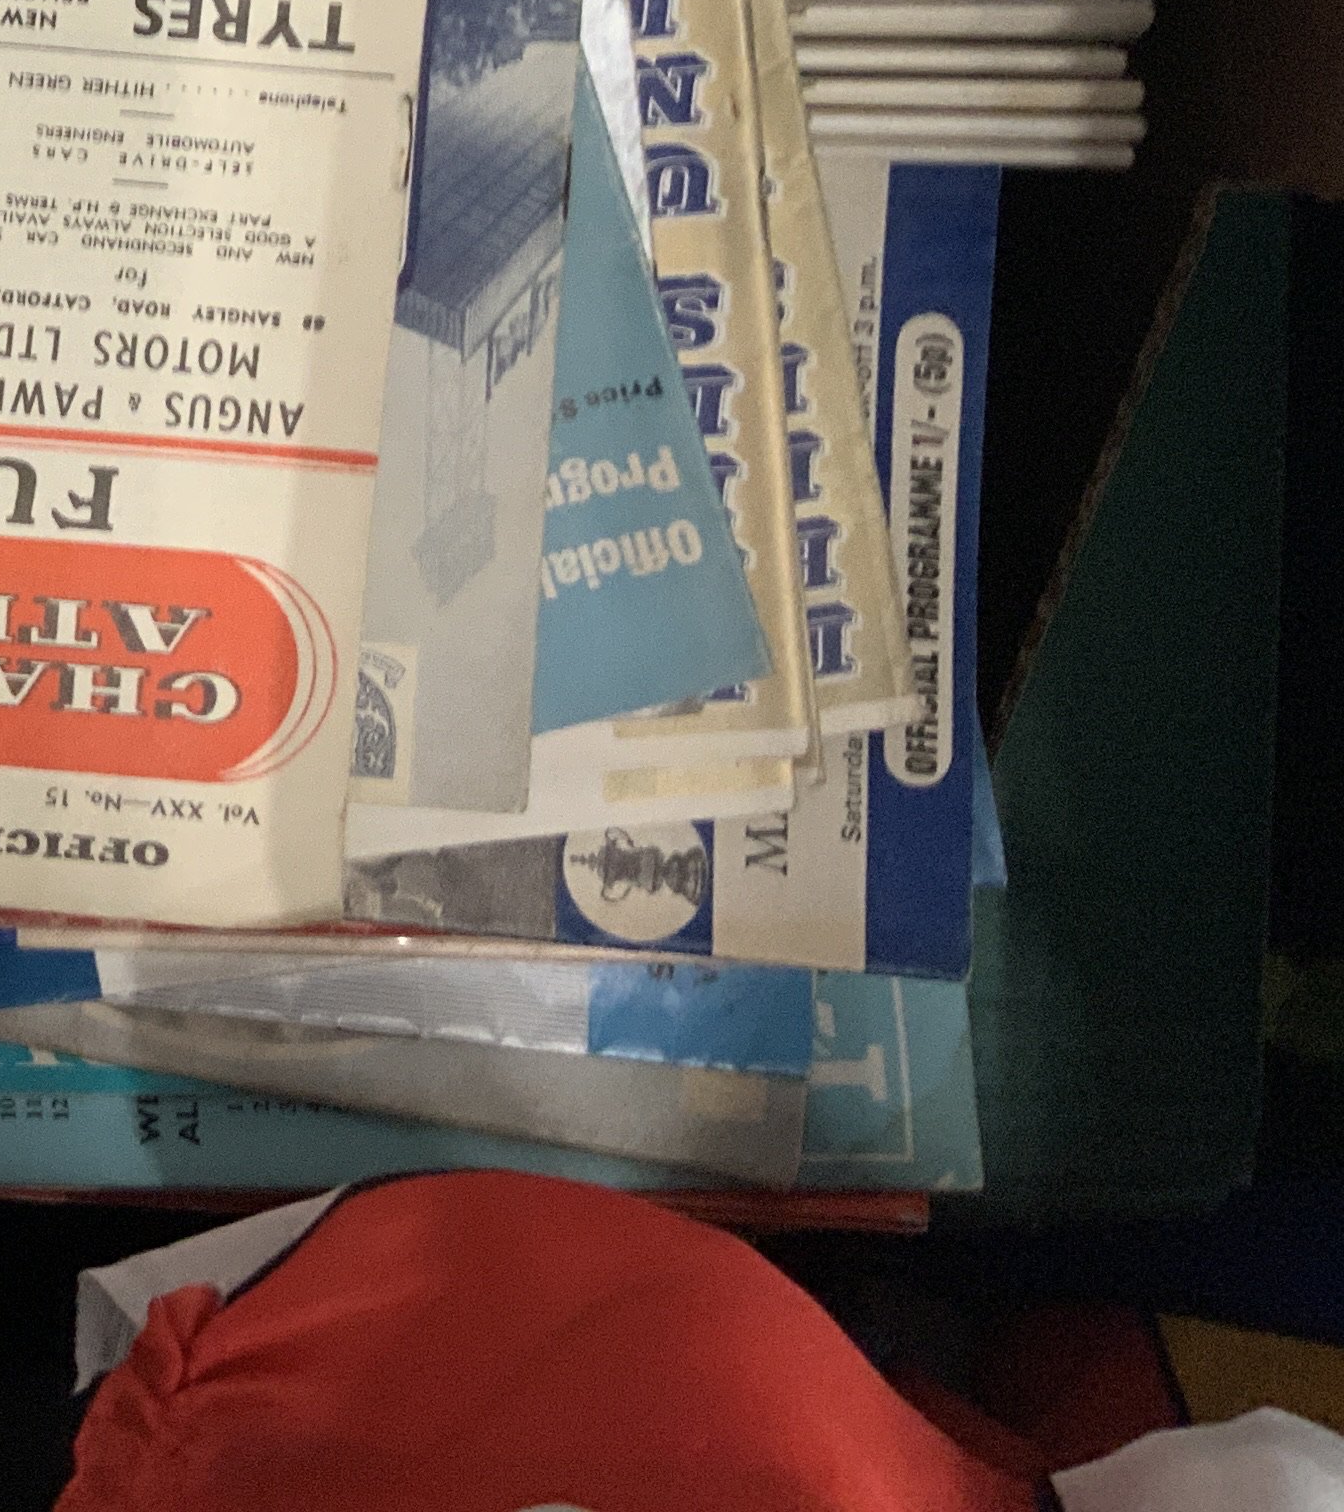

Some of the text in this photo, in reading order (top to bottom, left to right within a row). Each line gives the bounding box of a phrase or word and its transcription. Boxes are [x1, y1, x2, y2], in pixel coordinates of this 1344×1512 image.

[6, 69, 73, 92] GREEN
[80, 75, 156, 100] HITHER
[24, 229, 60, 247] CAR
[79, 232, 194, 258] SECONDHAND
[214, 243, 254, 263] AND
[273, 249, 316, 268] NEW
[111, 294, 172, 320] ROAD,
[190, 303, 282, 329] SANGLEY
[92, 328, 261, 381] MOTORS
[581, 376, 663, 410] Price
[163, 389, 306, 439] ANGUS
[540, 517, 703, 598] Official
[901, 455, 946, 642] PROGRAMME
